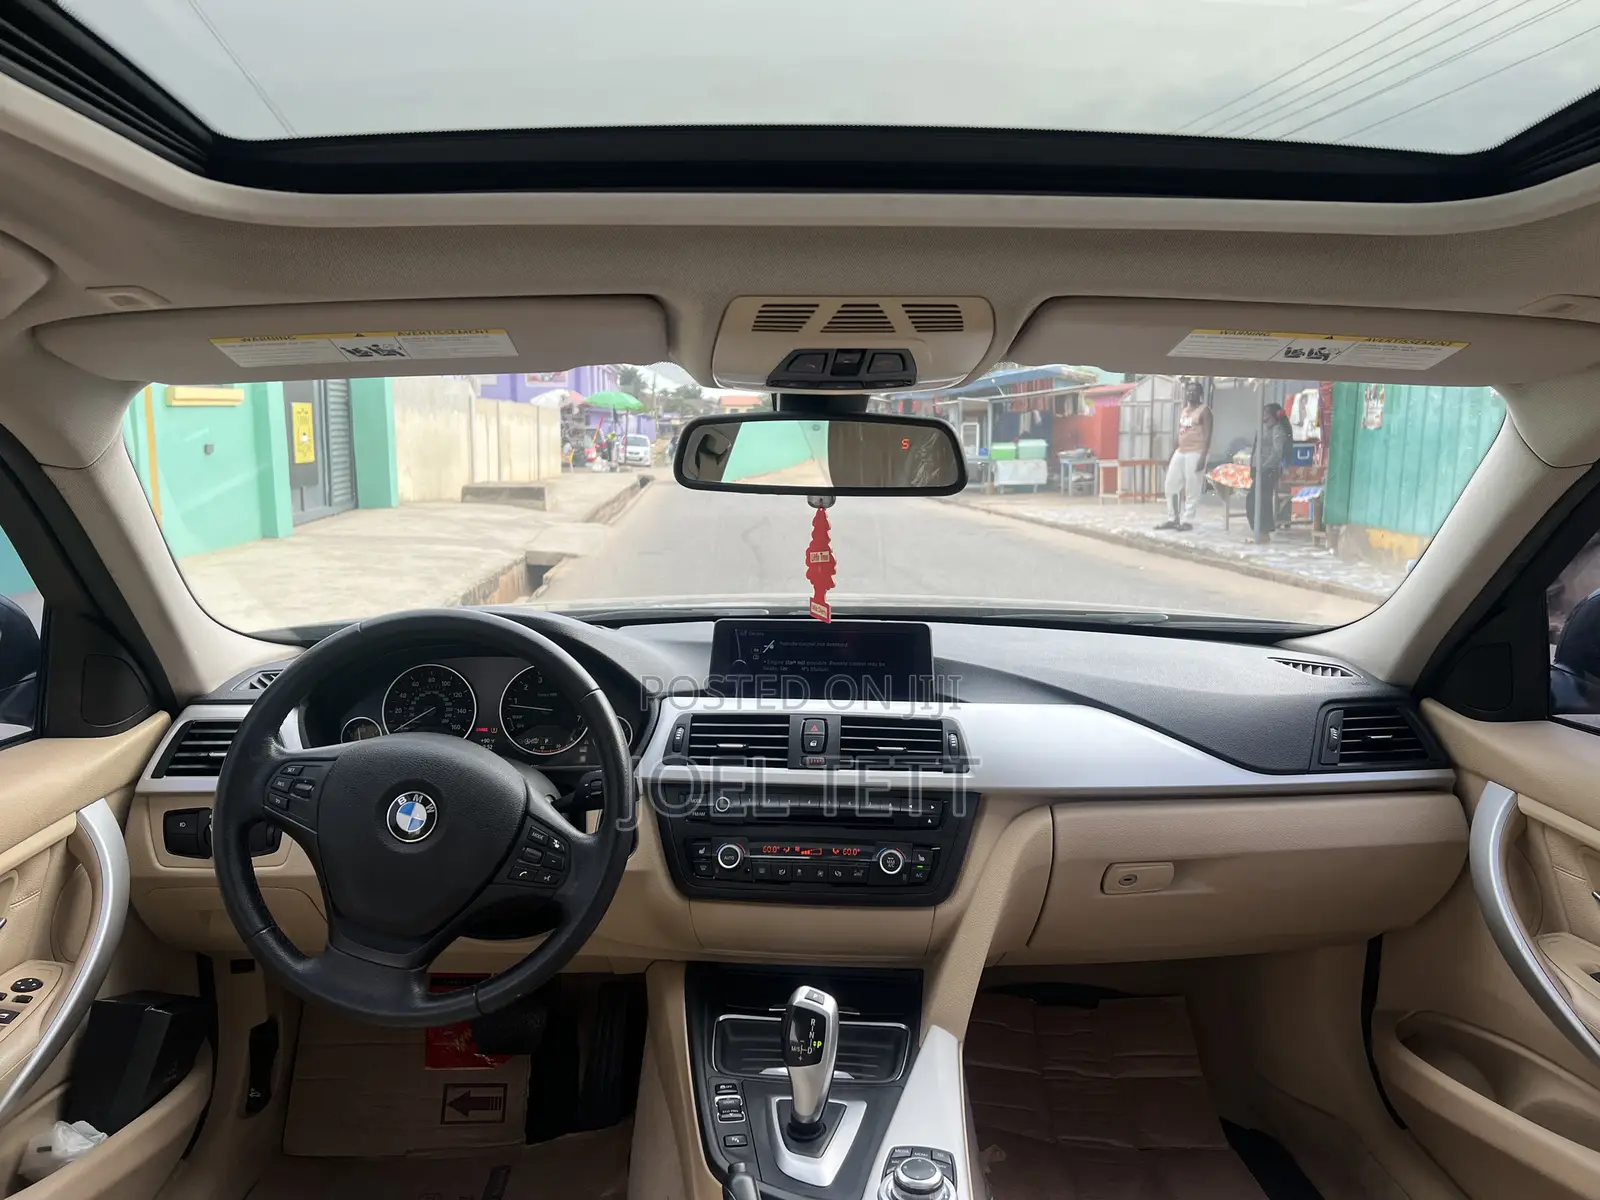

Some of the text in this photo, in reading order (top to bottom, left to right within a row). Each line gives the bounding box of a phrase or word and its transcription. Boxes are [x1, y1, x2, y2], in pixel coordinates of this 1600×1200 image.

[901, 437, 910, 450] S
[397, 794, 435, 813] BMW
[531, 831, 544, 841] MODE
[810, 1018, 816, 1026] R
[808, 1031, 815, 1039] N
[807, 1046, 813, 1054] D
